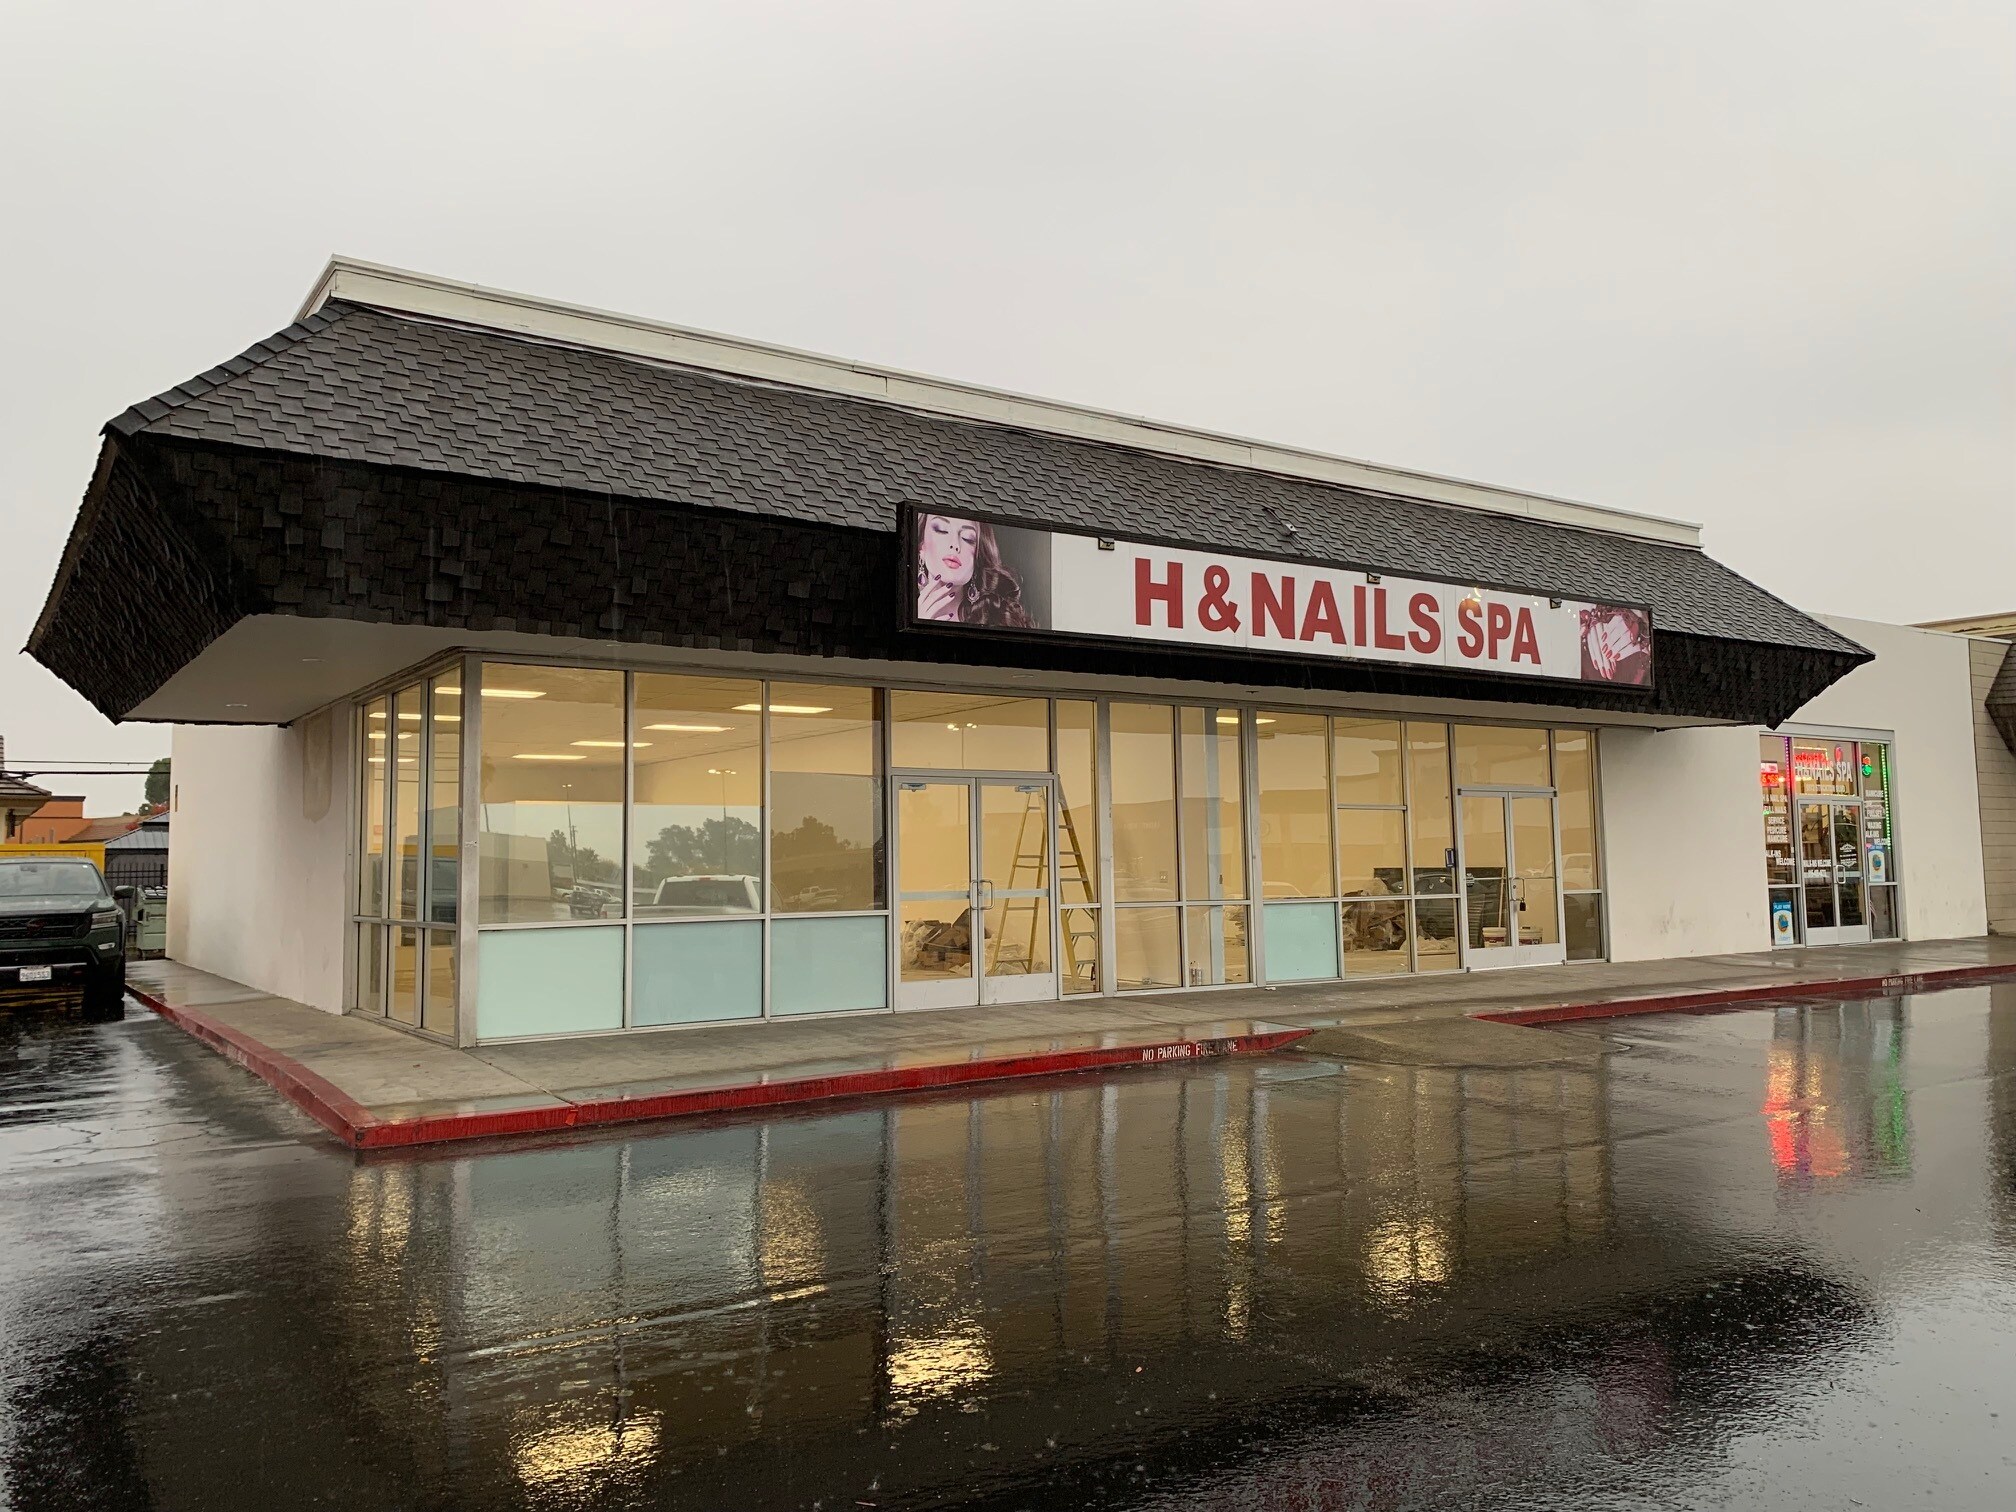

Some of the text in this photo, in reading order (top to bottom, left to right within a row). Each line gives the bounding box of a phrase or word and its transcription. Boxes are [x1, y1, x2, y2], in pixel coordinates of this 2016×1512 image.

[1457, 598, 1541, 665] SPA
[1836, 761, 1853, 782] SPA
[1775, 857, 1795, 866] WELCOME
[1142, 1049, 1154, 1061] NO
[1157, 1044, 1191, 1059] PARKING
[1195, 1043, 1214, 1056] FIRE
